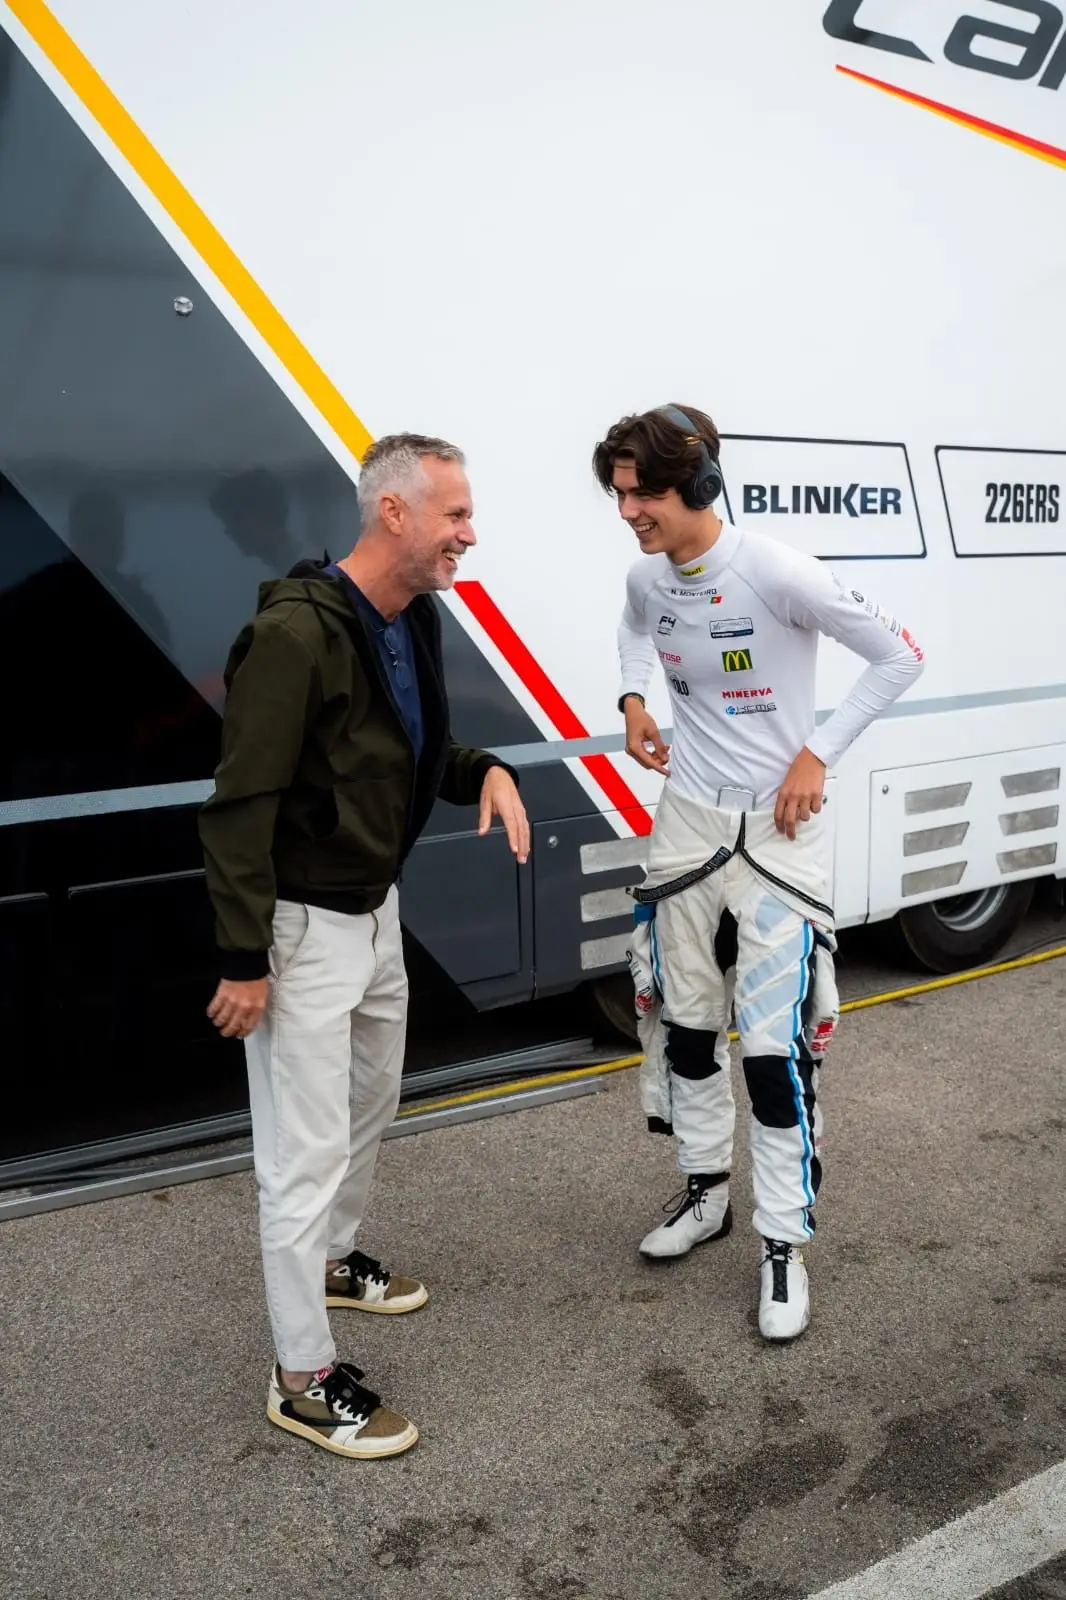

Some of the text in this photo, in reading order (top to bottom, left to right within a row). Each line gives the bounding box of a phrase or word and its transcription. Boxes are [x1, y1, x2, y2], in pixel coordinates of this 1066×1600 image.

[743, 483, 902, 518] BLINKER
[984, 483, 1060, 523] 226ERS
[679, 588, 717, 597] MONTEIRO
[659, 615, 677, 628] F4
[722, 687, 773, 699] MINERVA
